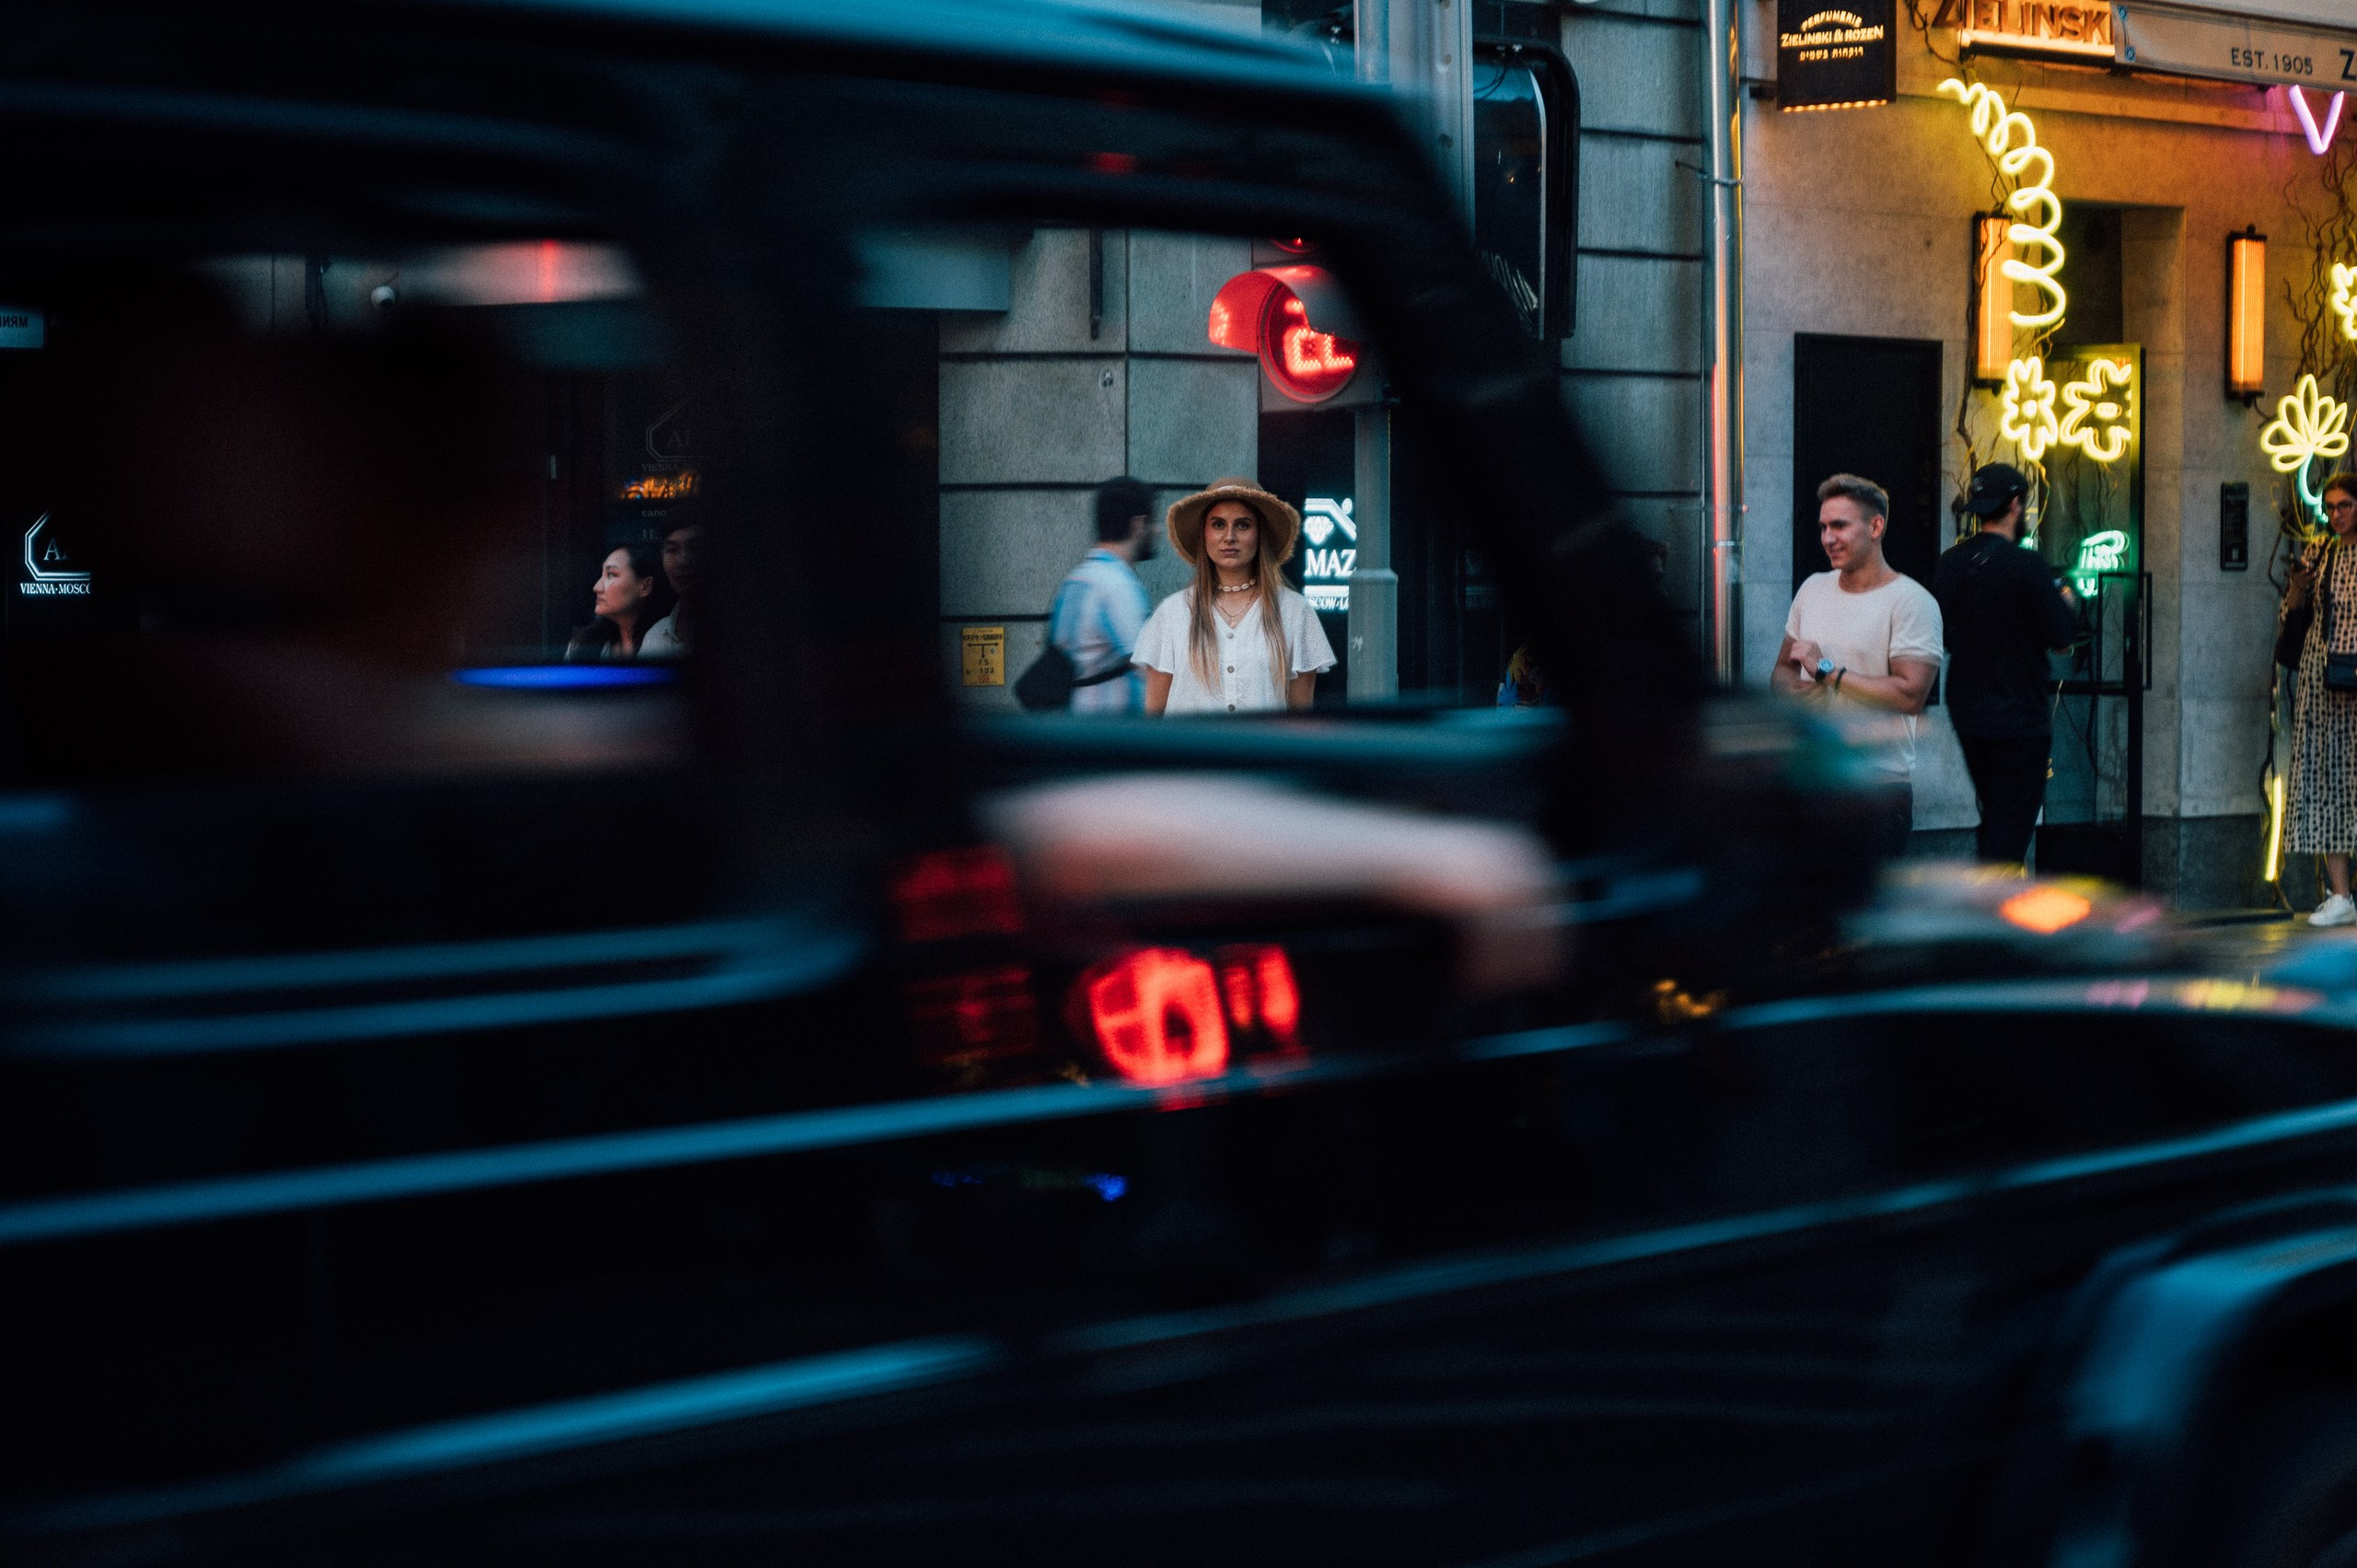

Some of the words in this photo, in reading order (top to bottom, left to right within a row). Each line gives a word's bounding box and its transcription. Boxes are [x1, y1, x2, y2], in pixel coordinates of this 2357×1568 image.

[1781, 31, 1832, 47] ZIELINSKI
[1845, 25, 1884, 41] ROZEN
[2230, 47, 2269, 70] EST.
[2273, 53, 2314, 75] 1905
[0, 315, 29, 328] ИЯМ
